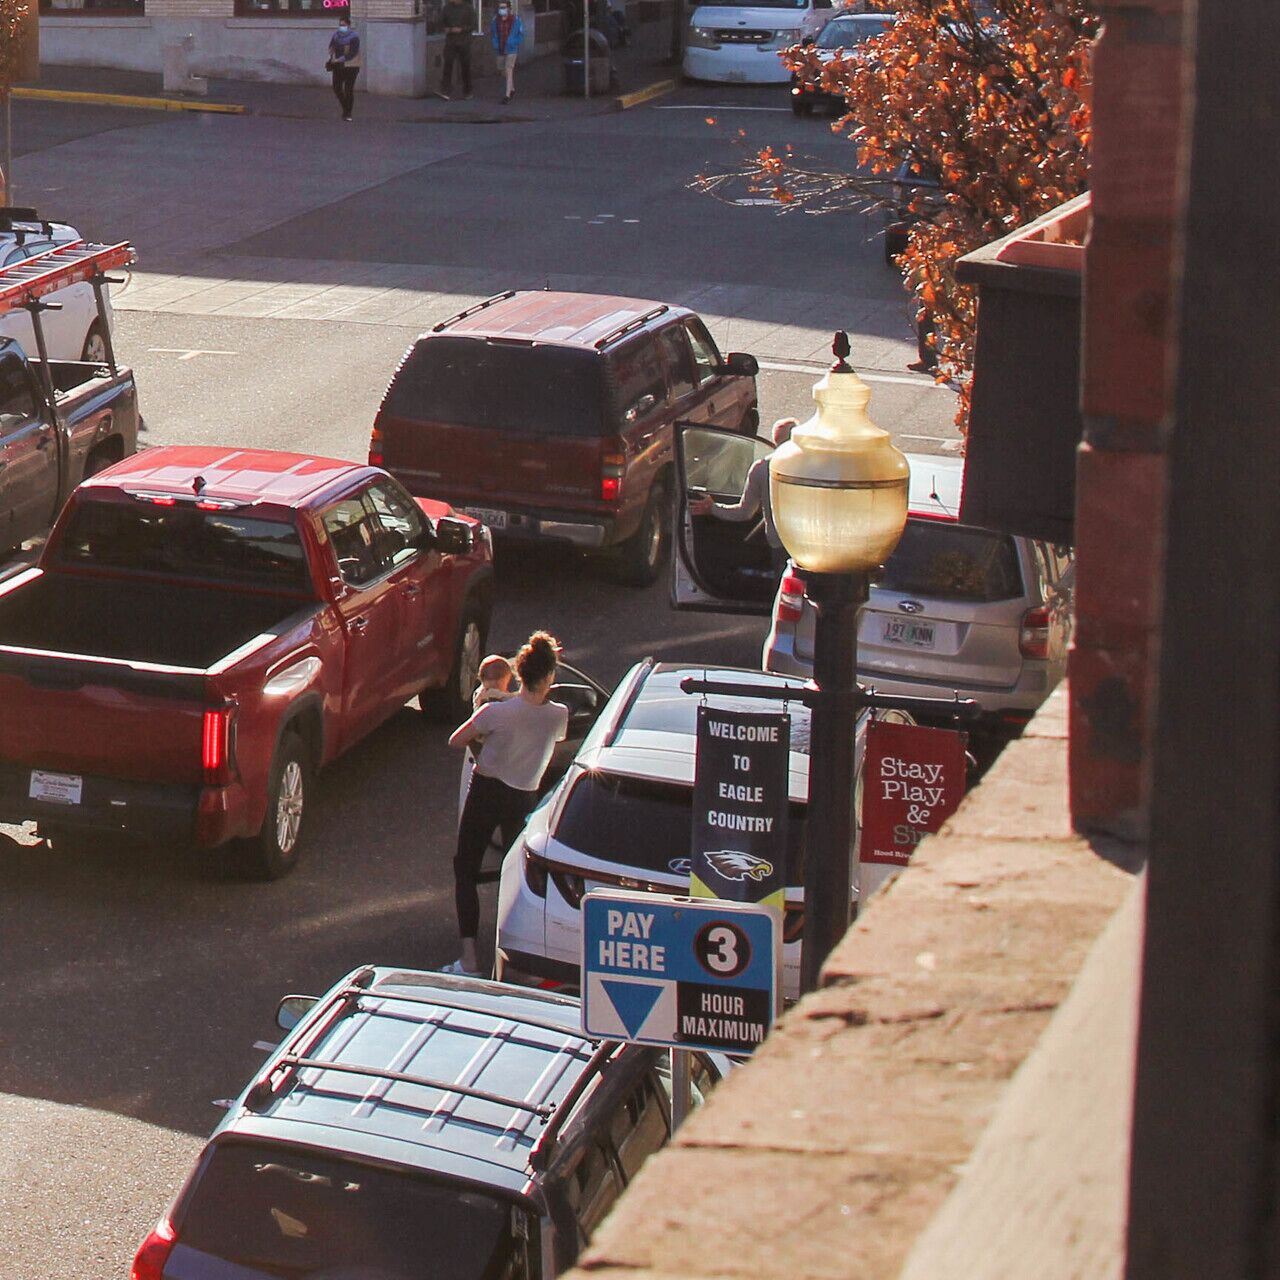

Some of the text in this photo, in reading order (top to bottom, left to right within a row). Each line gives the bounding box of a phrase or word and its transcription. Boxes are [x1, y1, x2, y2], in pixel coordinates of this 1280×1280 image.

[708, 720, 779, 743] WELCOME
[732, 754, 751, 772] TO
[880, 756, 945, 784] Stay,
[718, 782, 763, 803] EAGLE
[880, 779, 946, 807] Play,
[707, 809, 774, 833] COUNTRY
[906, 804, 931, 825] &
[873, 849, 894, 858] Hood
[607, 910, 655, 940] PAY
[598, 926, 739, 973] HERE 3
[700, 992, 744, 1017] HOUR
[682, 1016, 765, 1043] MAXIMUM
